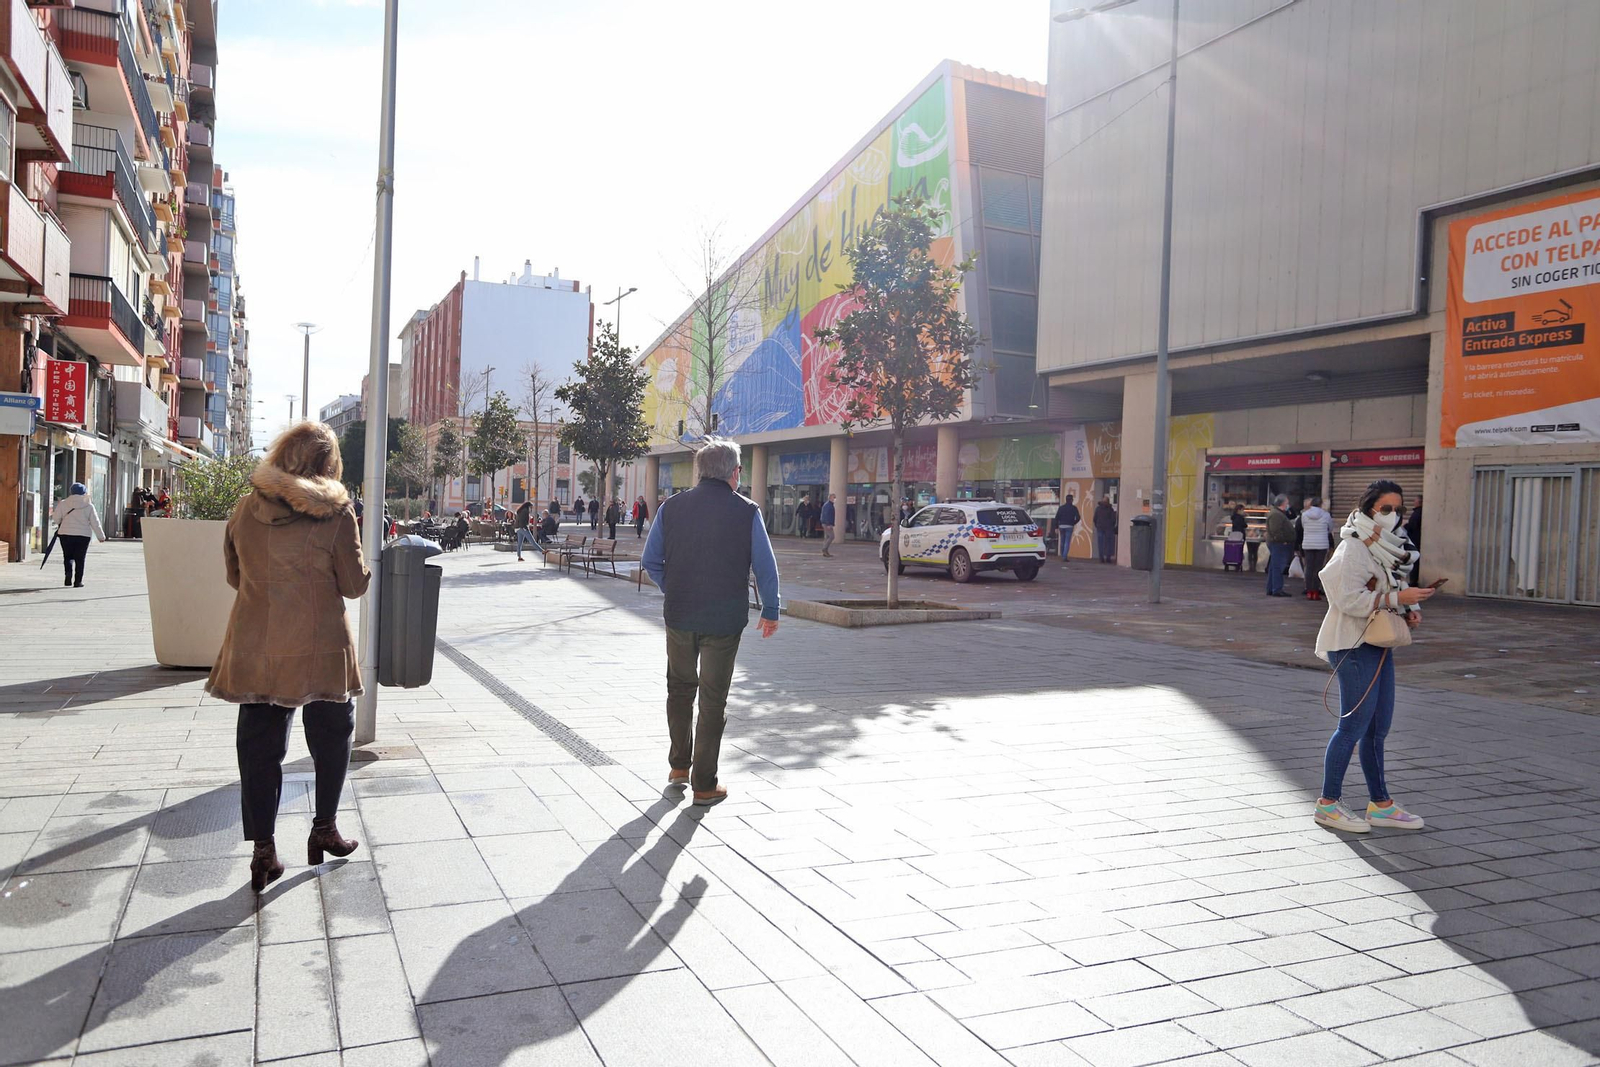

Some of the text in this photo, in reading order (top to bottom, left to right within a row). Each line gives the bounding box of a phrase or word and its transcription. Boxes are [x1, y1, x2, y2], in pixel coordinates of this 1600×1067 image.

[1472, 225, 1542, 254] ACCEDE
[1548, 220, 1573, 240] AL
[764, 170, 932, 331] Muy de Huela
[1501, 251, 1538, 272] CON
[1511, 275, 1531, 289] SIN
[1535, 267, 1579, 285] COGER
[1465, 318, 1508, 334] Activa
[1465, 329, 1573, 351] Entrada Express
[1476, 362, 1502, 370] barrera
[1503, 357, 1539, 368] reconocerá
[1550, 354, 1584, 364] matrícula
[1477, 369, 1498, 379] abrirá
[64, 363, 79, 423] 中国商城
[1474, 426, 1528, 434] www.telpark.com
[1093, 435, 1112, 462] Muy
[1379, 453, 1420, 462] CHURRERÍA
[1248, 458, 1280, 466] PANADERIA
